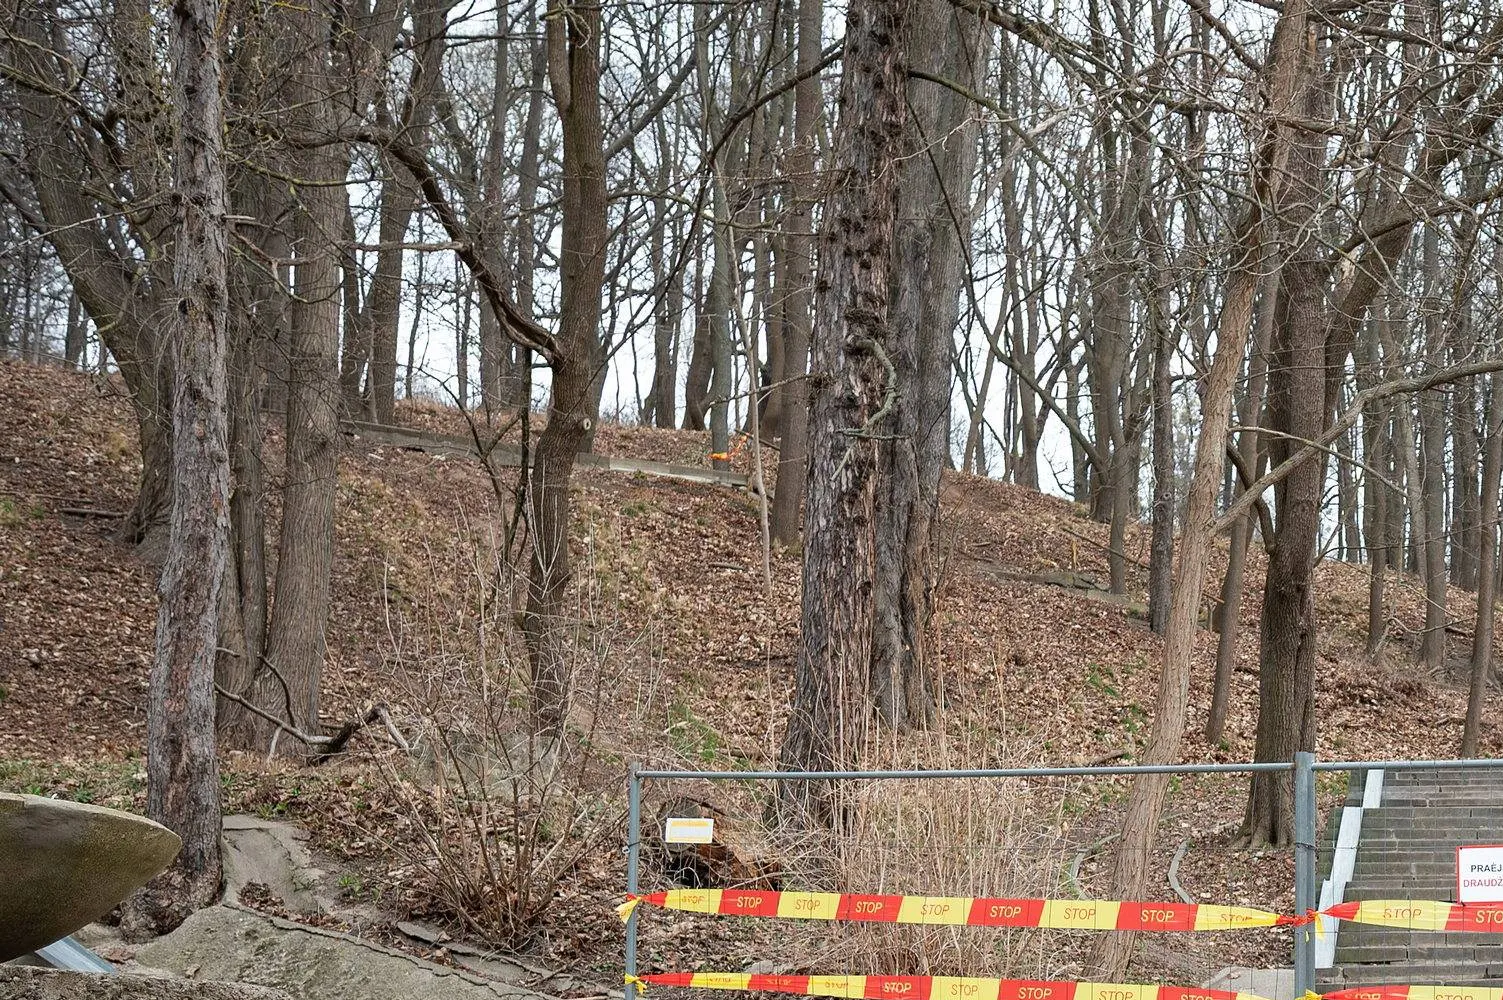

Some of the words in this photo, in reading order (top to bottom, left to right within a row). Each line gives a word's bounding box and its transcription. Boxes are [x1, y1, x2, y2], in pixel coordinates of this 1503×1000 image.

[737, 896, 763, 909] STOP
[795, 899, 821, 911] STOP
[855, 901, 883, 914] STOP
[920, 904, 950, 916] STOP
[990, 905, 1022, 918] STOP
[1063, 908, 1096, 920] STOP
[1141, 909, 1175, 922] STOP
[1383, 908, 1422, 919] STOP
[884, 982, 912, 994] STOP
[951, 984, 979, 996] STOP
[1018, 987, 1053, 1000] STOP
